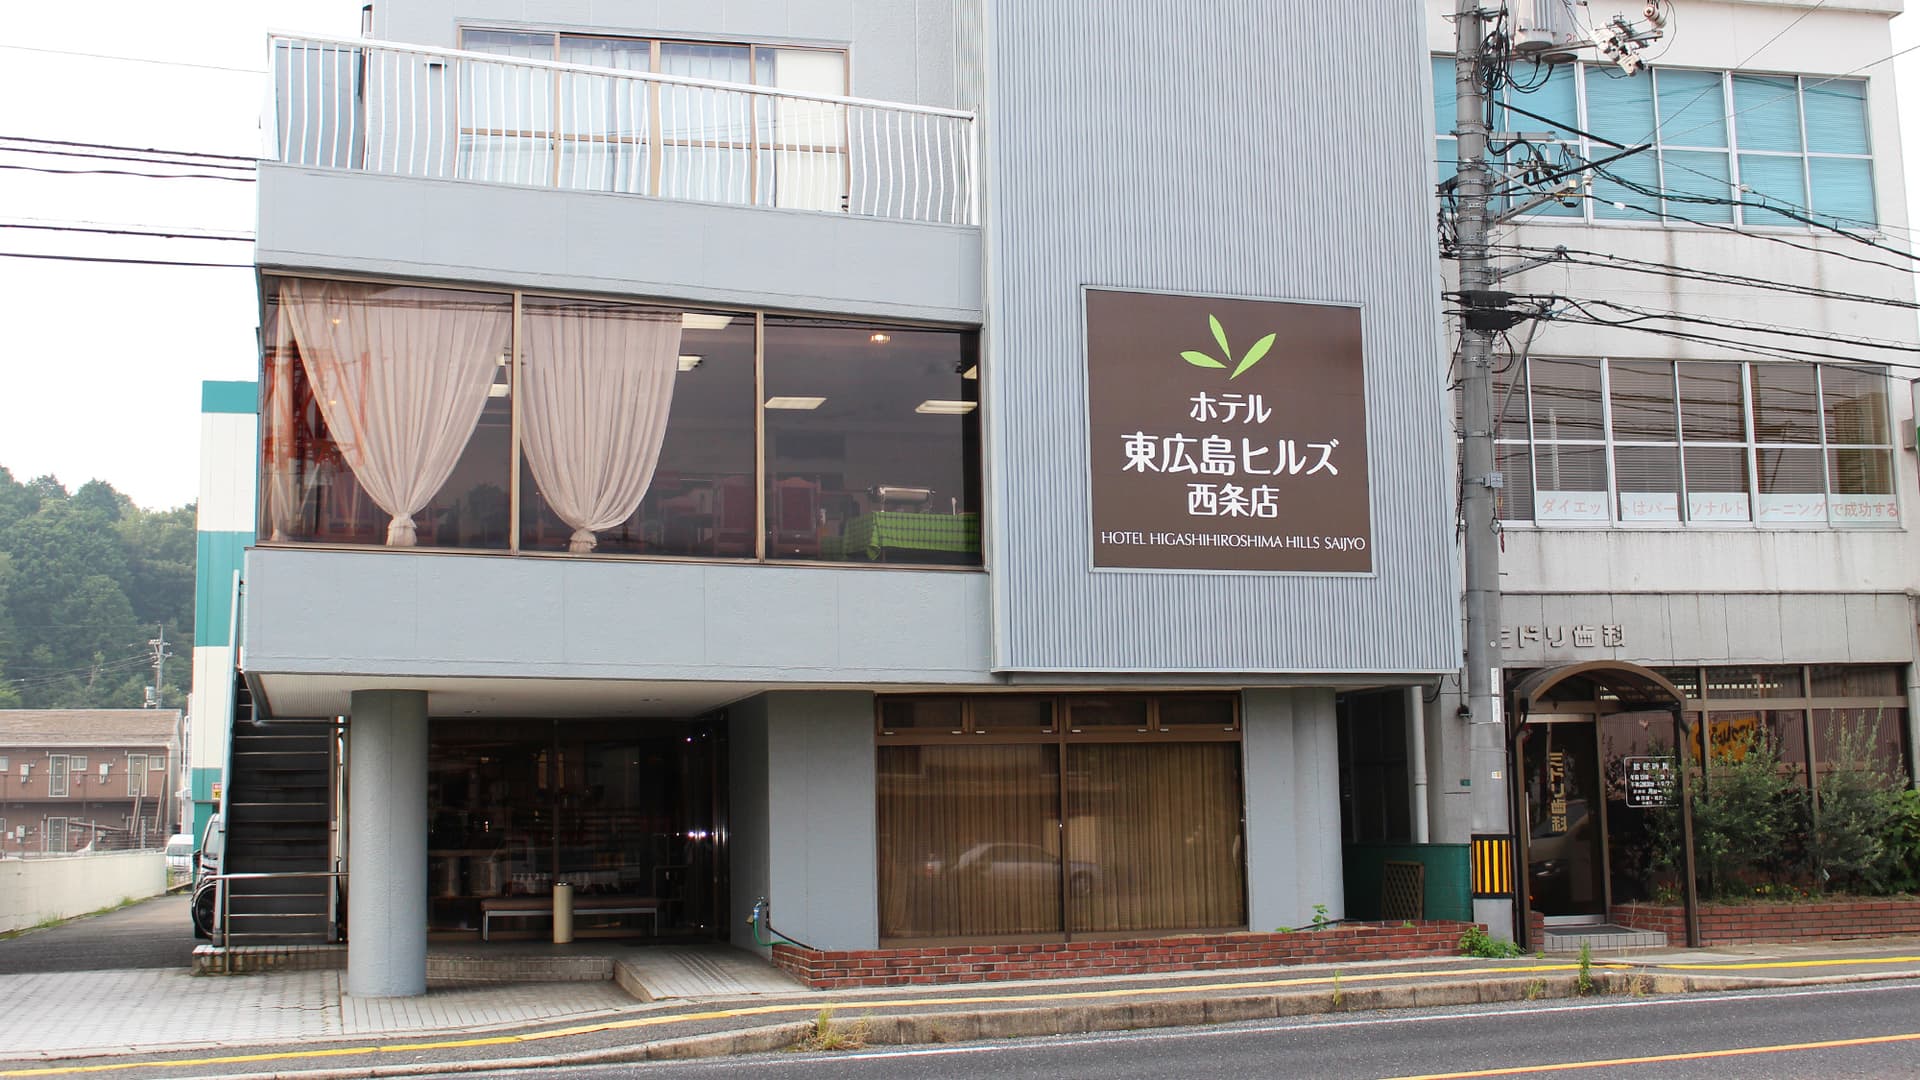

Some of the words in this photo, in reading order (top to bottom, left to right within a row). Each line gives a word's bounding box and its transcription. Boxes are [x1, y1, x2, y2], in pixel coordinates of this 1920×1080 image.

[1190, 392, 1271, 423] ホテル
[1121, 431, 1339, 475] 東広島ヒルズ
[1187, 483, 1279, 517] 西条店
[1102, 532, 1146, 544] HOTEL
[1150, 532, 1283, 547] HIGASHIHIROSHIMA
[1286, 535, 1320, 549] HILLS
[1325, 536, 1366, 551] SAIJYO
